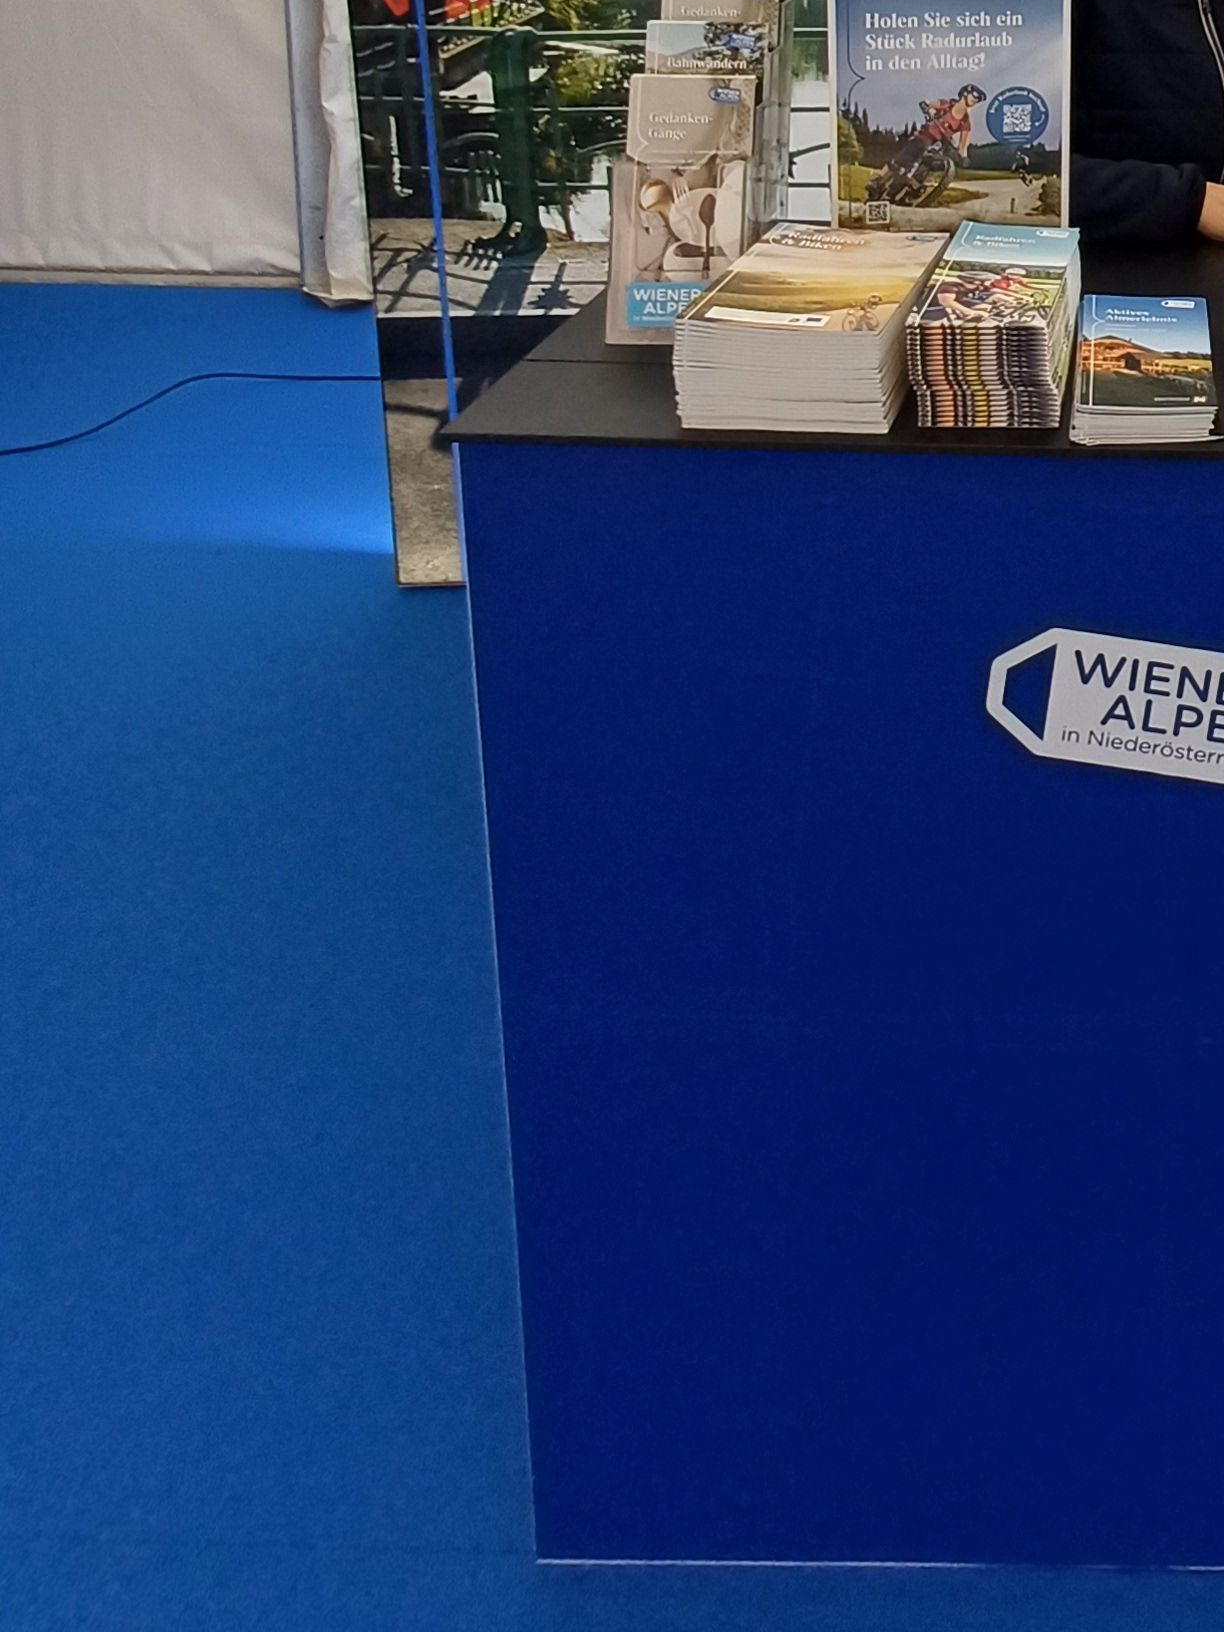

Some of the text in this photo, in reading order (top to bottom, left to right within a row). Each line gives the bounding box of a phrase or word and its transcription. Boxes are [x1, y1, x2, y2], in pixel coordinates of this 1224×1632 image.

[681, 5, 742, 17] Gedanken-
[865, 11, 1023, 29] Holen Sie sich ein
[865, 32, 1013, 50] Stück Radurlaub
[667, 56, 748, 69] Bahnwandern
[865, 52, 986, 72] in den Alltag!
[650, 112, 713, 124] Gedanken-
[649, 127, 687, 140] Gänge
[1105, 308, 1150, 316] Aktives
[1061, 726, 1080, 743] in
